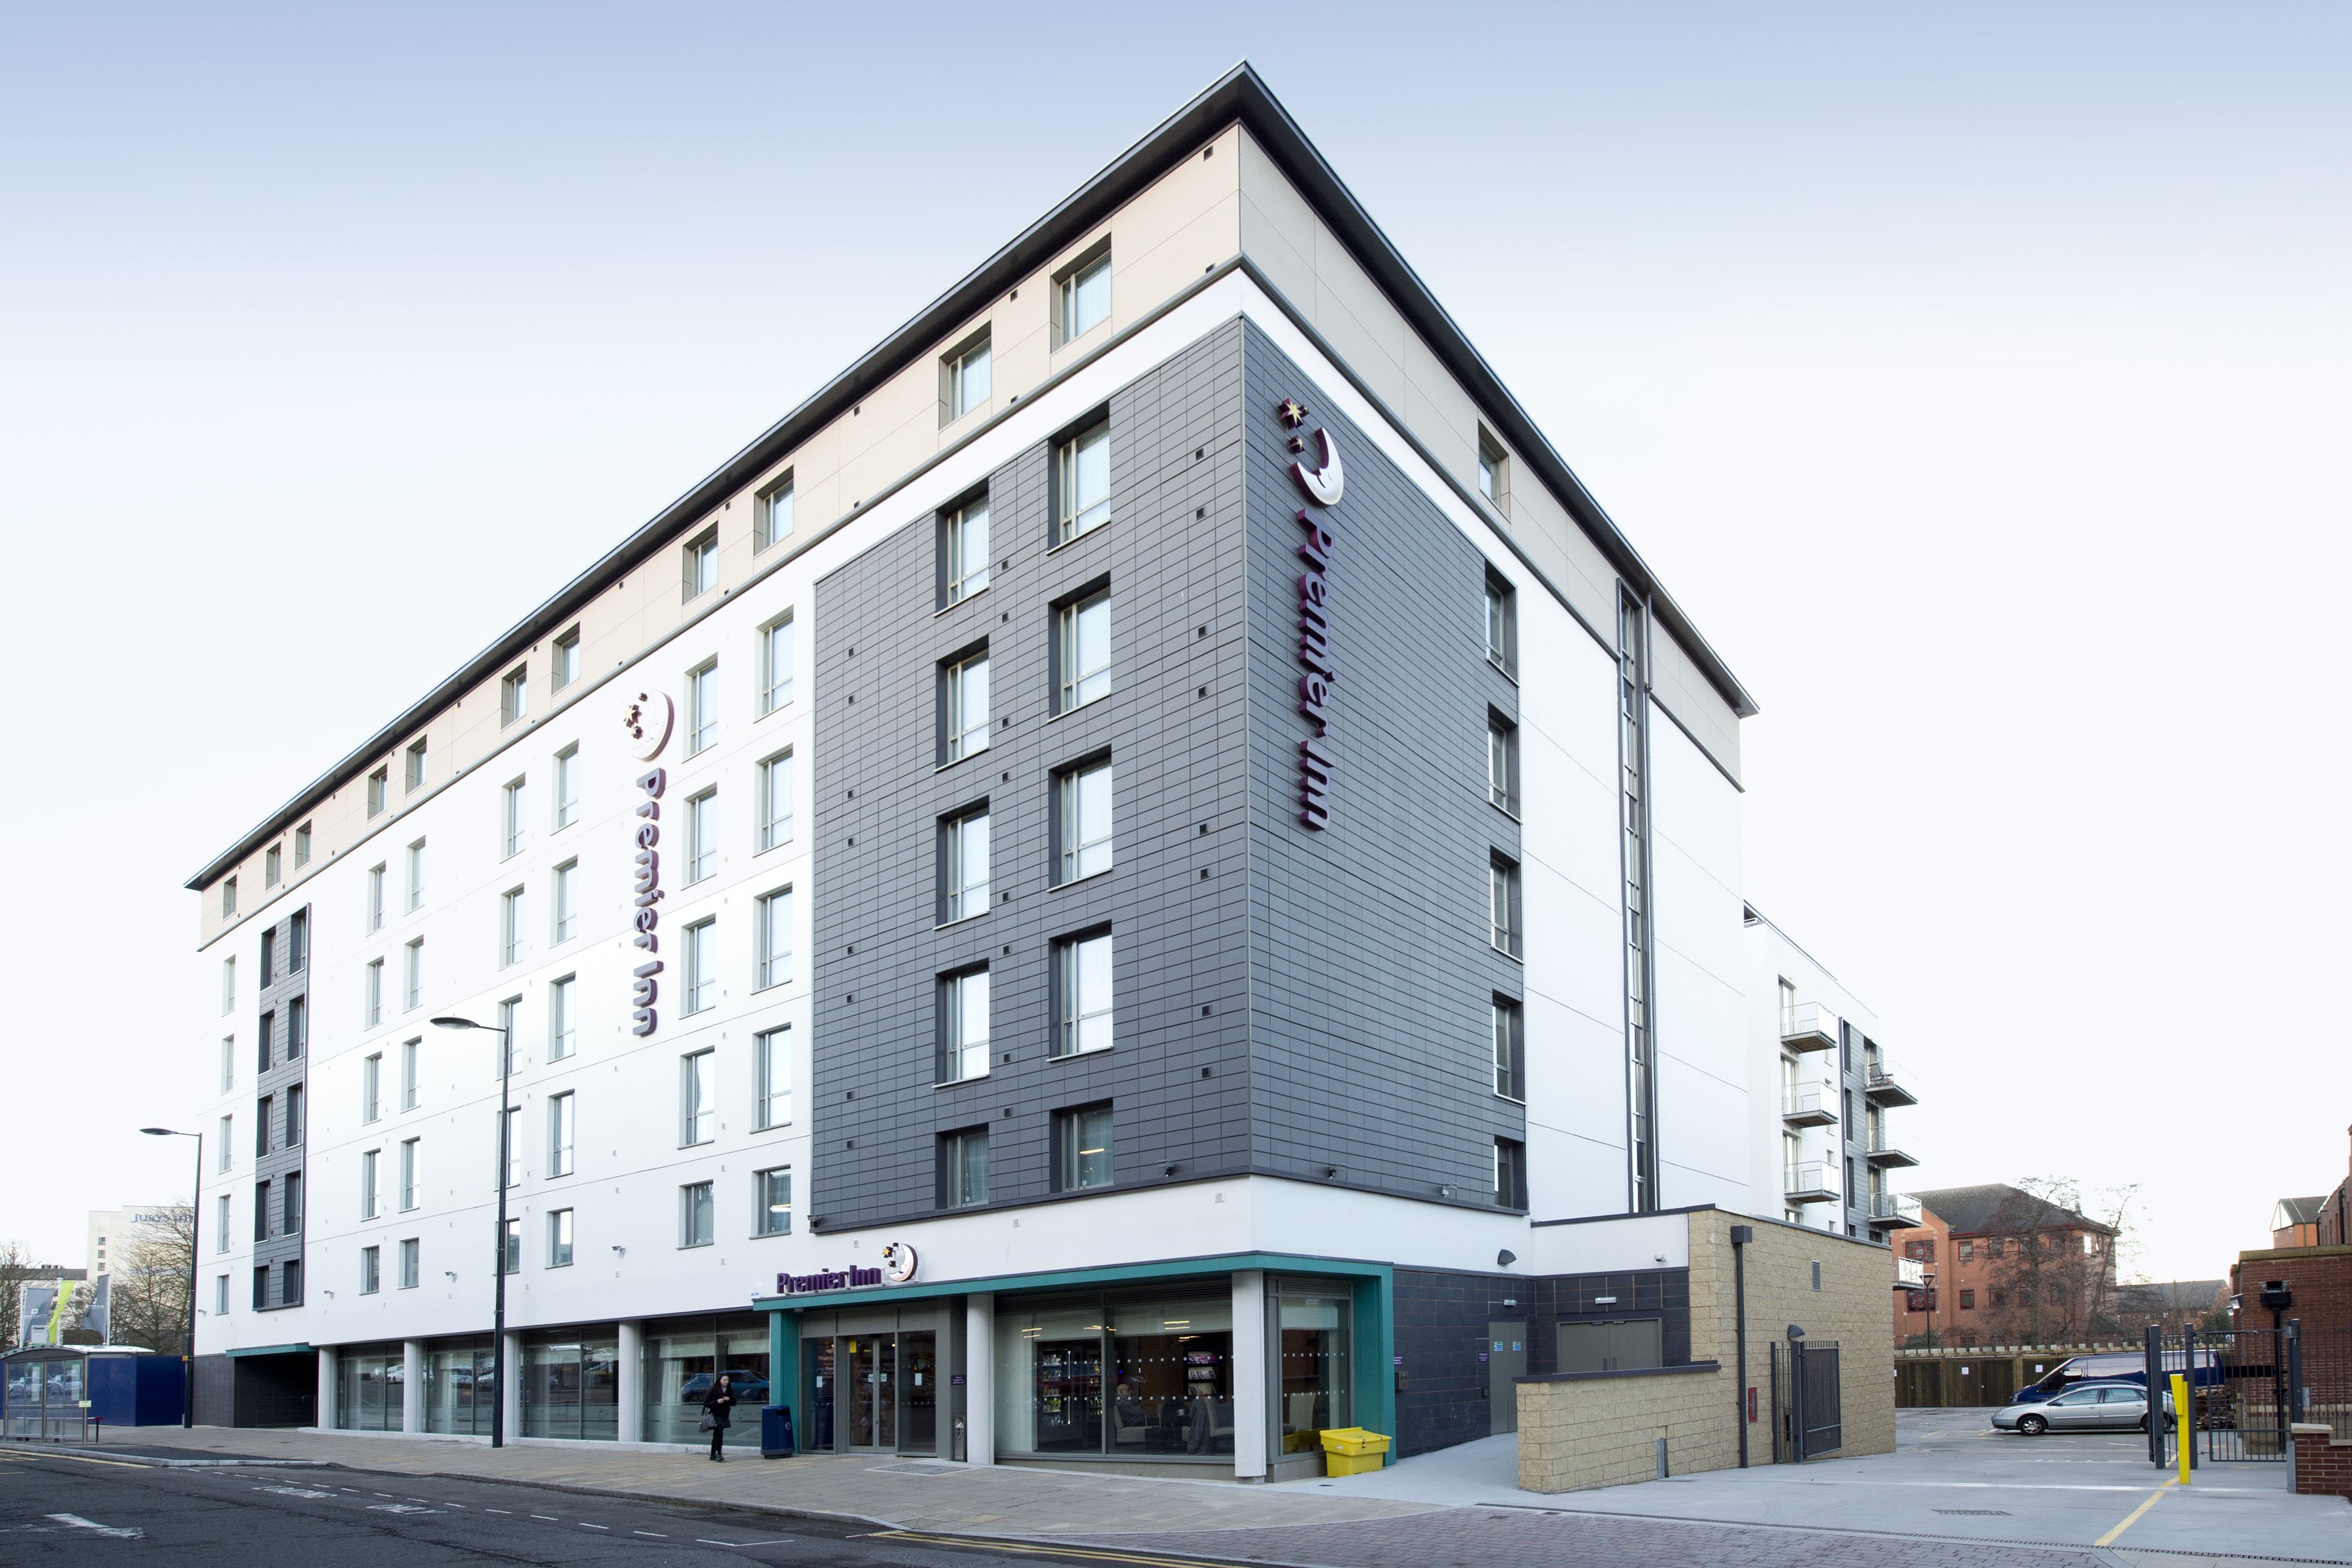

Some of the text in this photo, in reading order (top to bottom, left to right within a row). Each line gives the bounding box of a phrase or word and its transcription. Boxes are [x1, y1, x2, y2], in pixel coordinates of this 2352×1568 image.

[1298, 508, 1338, 832] Premier Inn
[632, 767, 666, 1037] Premier Inn
[776, 1264, 882, 1294] Premier Inn
